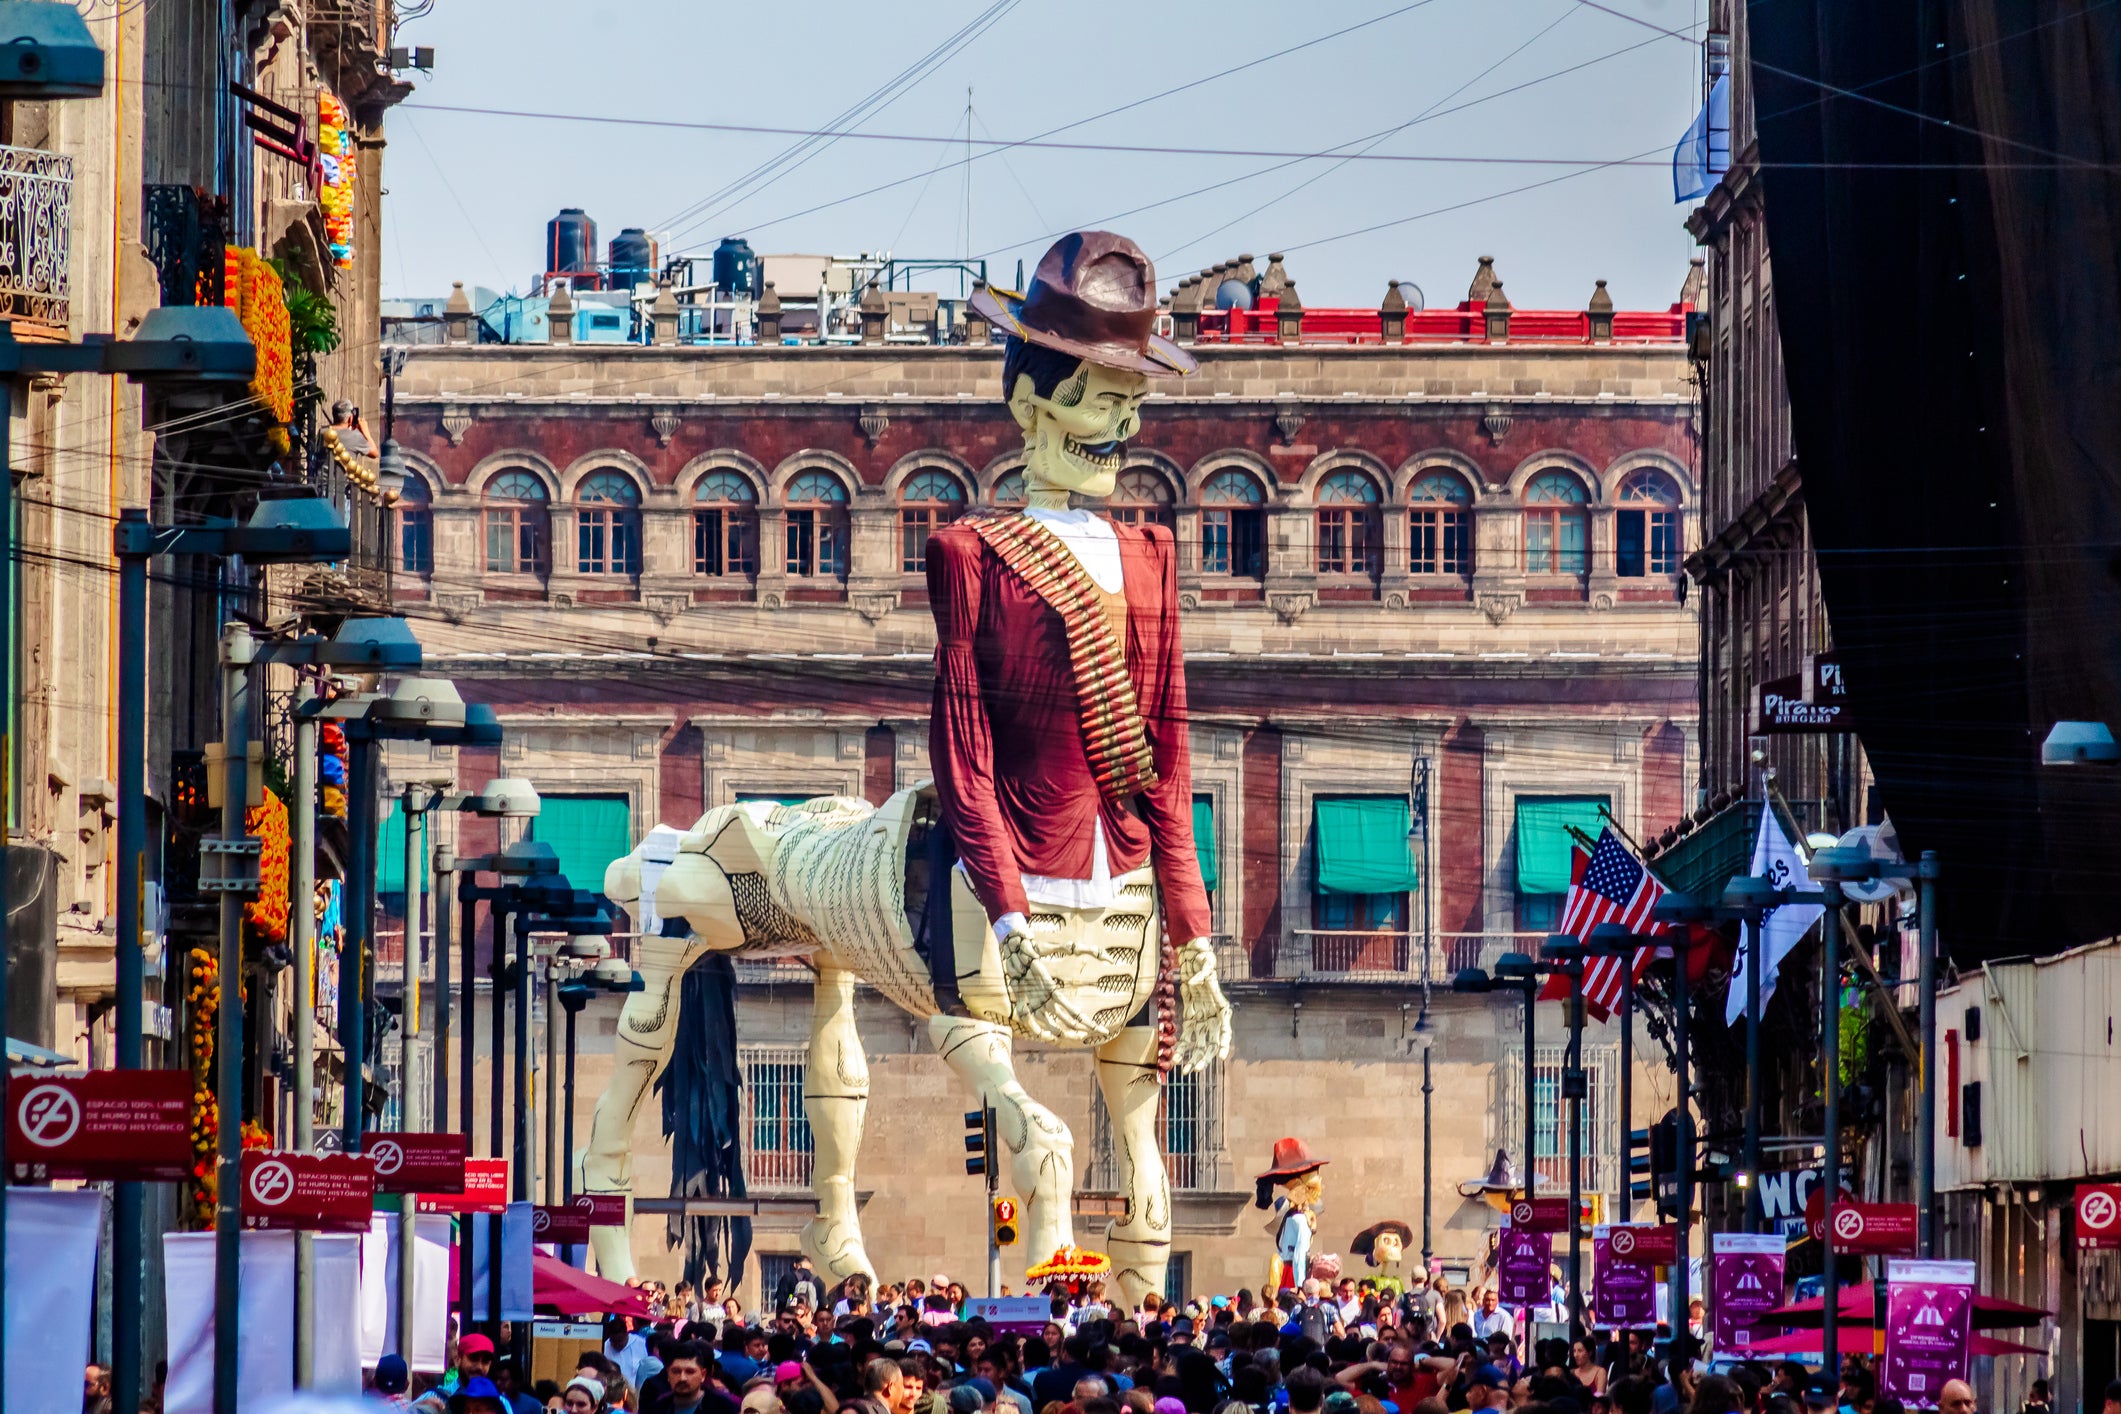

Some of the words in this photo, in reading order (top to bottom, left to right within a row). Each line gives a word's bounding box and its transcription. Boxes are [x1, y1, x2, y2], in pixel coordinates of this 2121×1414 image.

[1775, 715, 1831, 724] BURGERS
[86, 1101, 128, 1109] ESPACIO
[131, 1101, 154, 1109] 100%
[157, 1101, 184, 1109] LIBRE
[86, 1112, 99, 1120] DE
[102, 1112, 131, 1120] HUMO
[134, 1112, 147, 1120] EN
[150, 1112, 160, 1120] EL
[86, 1123, 127, 1131] CENTRO
